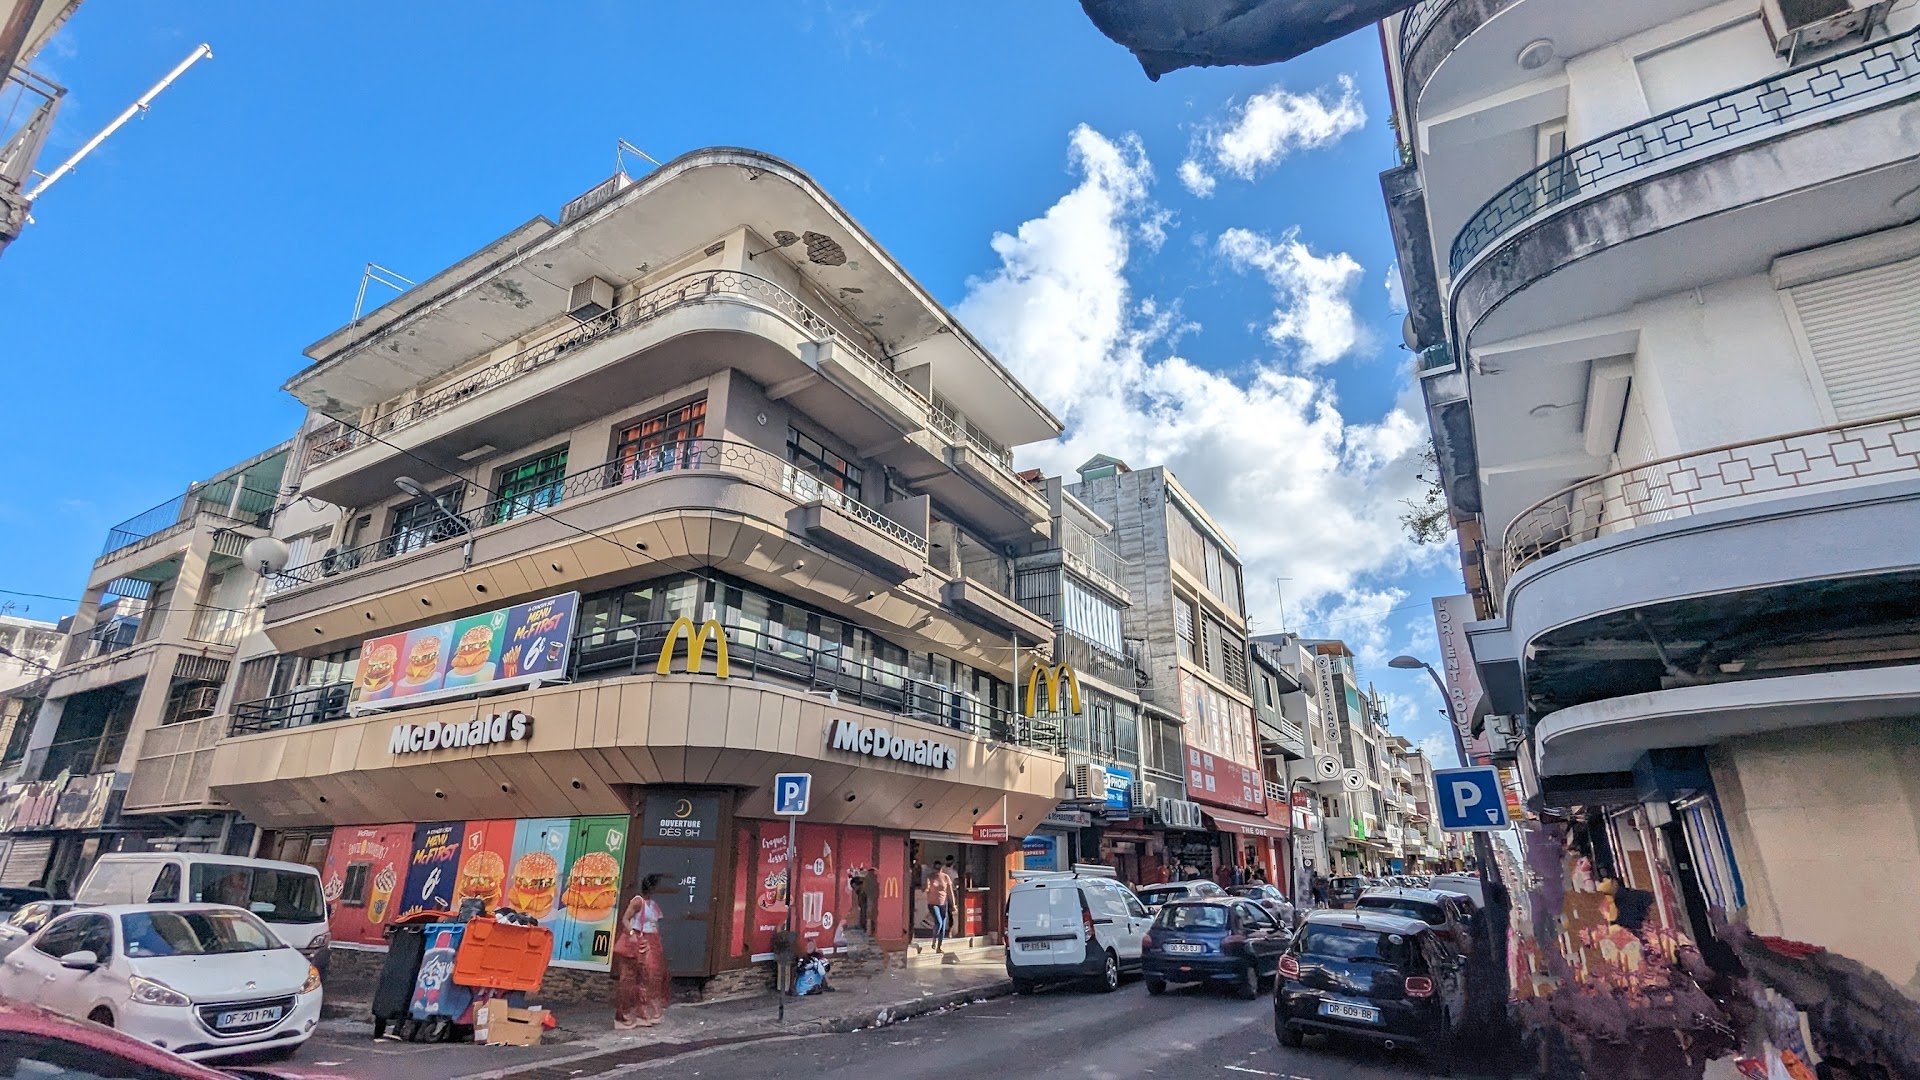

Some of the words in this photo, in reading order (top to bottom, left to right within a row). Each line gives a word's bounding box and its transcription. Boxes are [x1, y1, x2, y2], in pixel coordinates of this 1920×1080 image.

[514, 612, 564, 642] McFIRST
[527, 606, 552, 624] MENU
[1438, 600, 1460, 682] L'ORIENT
[1452, 687, 1473, 750] ROUGE
[1321, 668, 1335, 728] SEBASTIANO
[388, 711, 527, 754] McDonald's
[832, 719, 957, 770] McDonald's
[784, 782, 800, 806] P
[1452, 780, 1482, 818] P
[660, 819, 701, 828] OUVERTURE
[685, 829, 700, 837] 9H
[1241, 826, 1254, 834] THE
[426, 833, 448, 848] MENU
[413, 843, 459, 865] McFIRST
